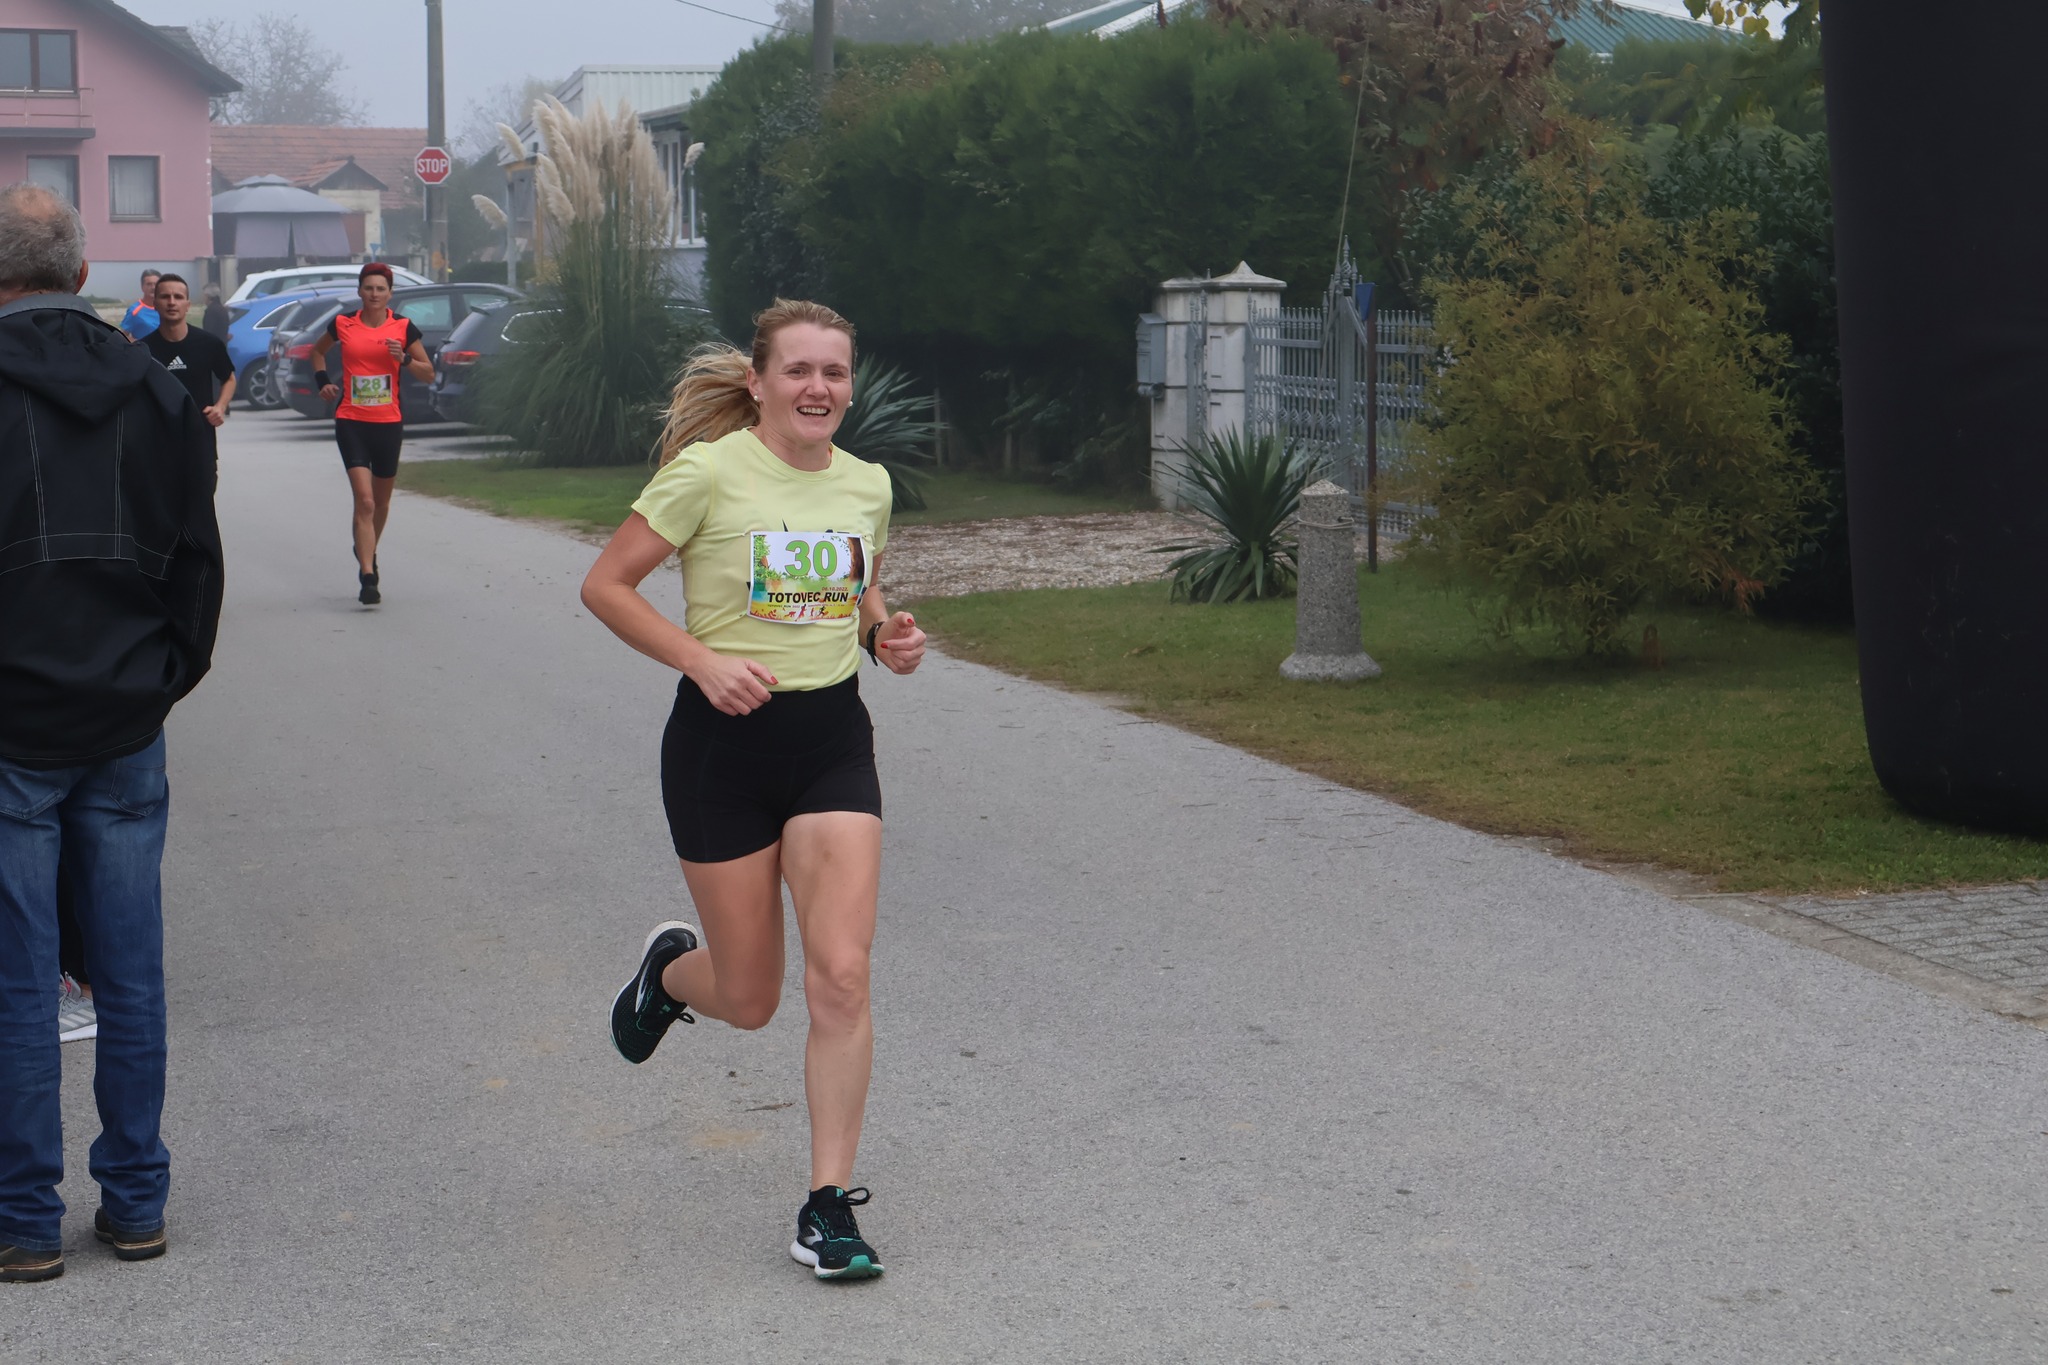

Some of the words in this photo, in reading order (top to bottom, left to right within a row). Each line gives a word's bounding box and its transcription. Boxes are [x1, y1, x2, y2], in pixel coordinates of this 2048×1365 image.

[418, 158, 449, 173] STOP
[361, 378, 382, 391] 28
[784, 540, 838, 578] 30
[767, 592, 821, 603] TOTOVEC
[824, 592, 849, 603] RUN
